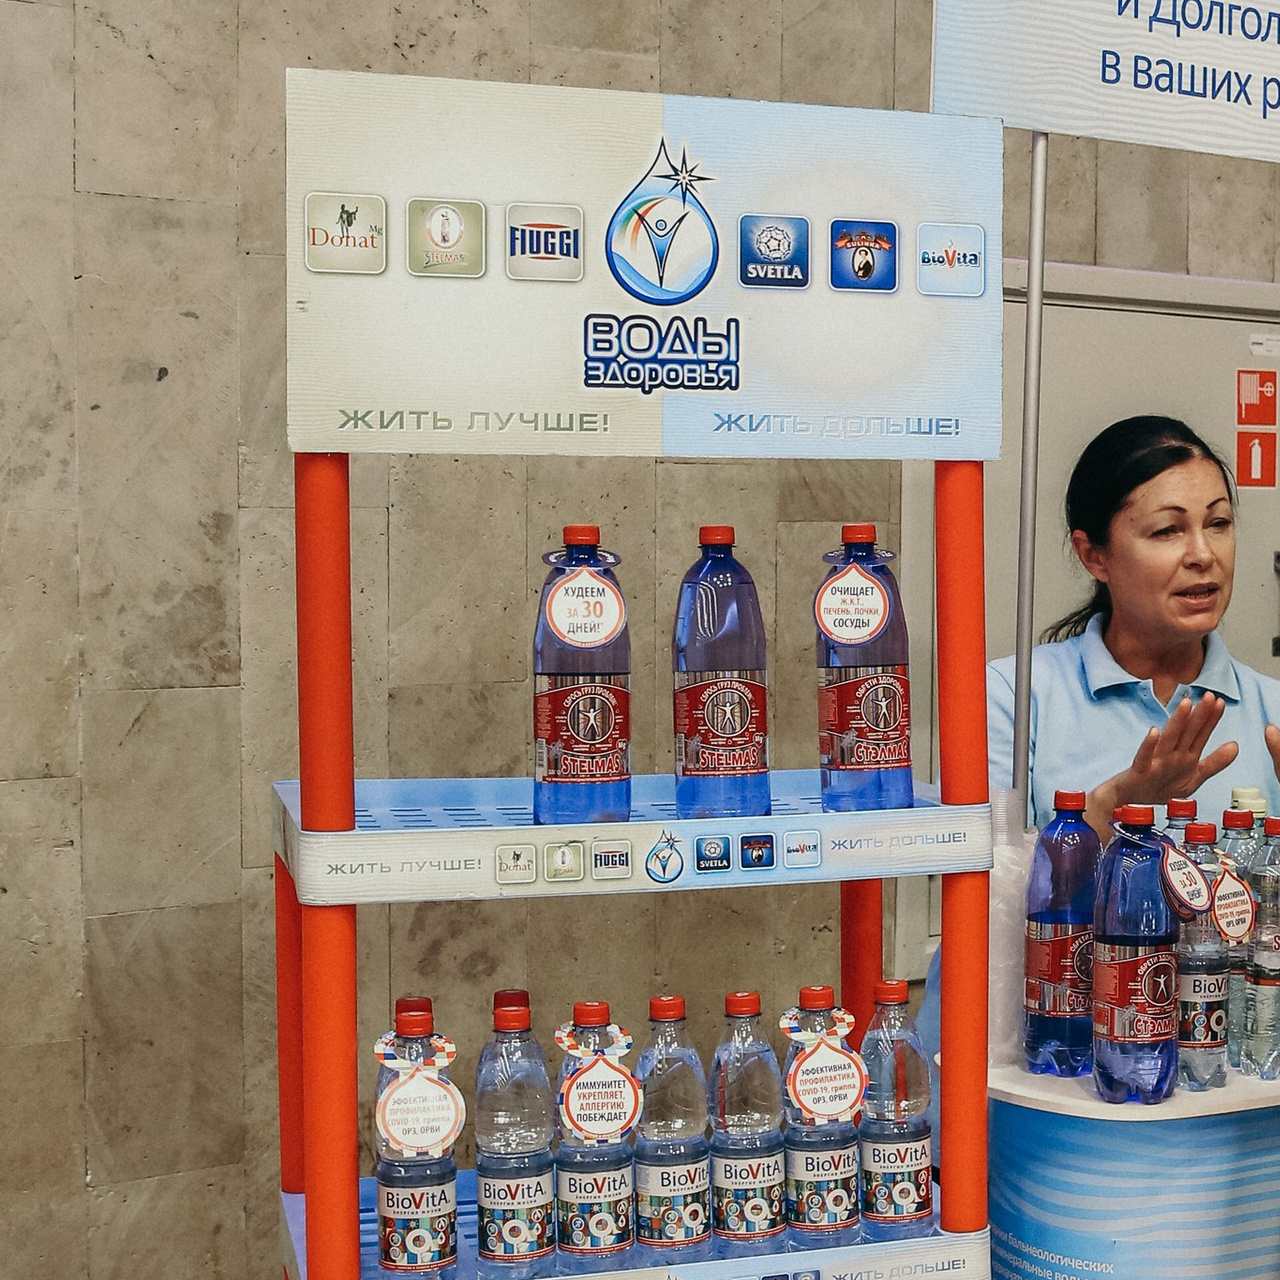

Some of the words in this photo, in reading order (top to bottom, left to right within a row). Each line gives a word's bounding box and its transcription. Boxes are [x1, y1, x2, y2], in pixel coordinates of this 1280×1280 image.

[1101, 50, 1122, 84] в
[1132, 55, 1252, 105] ваших
[310, 226, 378, 248] Donat
[369, 224, 383, 236] Mg
[509, 225, 579, 259] FIUGGI
[423, 251, 466, 267] STELMAS
[920, 249, 981, 268] BioVita
[747, 263, 803, 280] SVETLA
[584, 315, 740, 362] ВОДЫ
[338, 409, 453, 433] ЖИТЬ
[466, 411, 610, 435] ЛУЧШЕ!
[712, 412, 815, 435] ЖИТЬ
[819, 414, 961, 438] ДОЛЬШЕ!
[563, 586, 606, 599] ХУДЕЕМ
[830, 586, 874, 597] ОЧИЩАЕТ
[566, 607, 578, 618] ЗА
[581, 600, 604, 619] 30
[833, 617, 870, 630] СОСУДЫ
[561, 754, 620, 775] STELMAS
[699, 747, 758, 768] STELMAS
[831, 838, 884, 851] ЖИТЬ
[888, 832, 967, 848] ДОЛЬШЕ!
[326, 862, 391, 875] ЖИТЬ
[399, 859, 482, 873] ЛУЧШЕ!
[594, 852, 629, 868] FIUGGI
[700, 859, 728, 869] SVETLA
[1183, 871, 1198, 887] 30
[799, 1073, 855, 1085] ПРОФИЛАКТИКА
[800, 1063, 852, 1076] ЭФФЕКТИВНАЯ
[575, 1080, 626, 1090] ИММУНИТЕТ
[579, 1101, 624, 1111] АЛЛЕРГИЮ
[829, 1093, 848, 1103] ОРВИ
[576, 1111, 627, 1122] ПОБЕЖДАЕТ
[420, 1126, 441, 1134] ОРВИ
[872, 1144, 927, 1164] BioVitA
[724, 1160, 780, 1179] BioVitA
[484, 1181, 543, 1200] BioVitA
[569, 1174, 628, 1194] BioVitA
[386, 1189, 447, 1209] BioVitA
[1008, 1233, 1114, 1274] бальнеологических
[888, 1258, 966, 1279] ДОЛЬШЕ!
